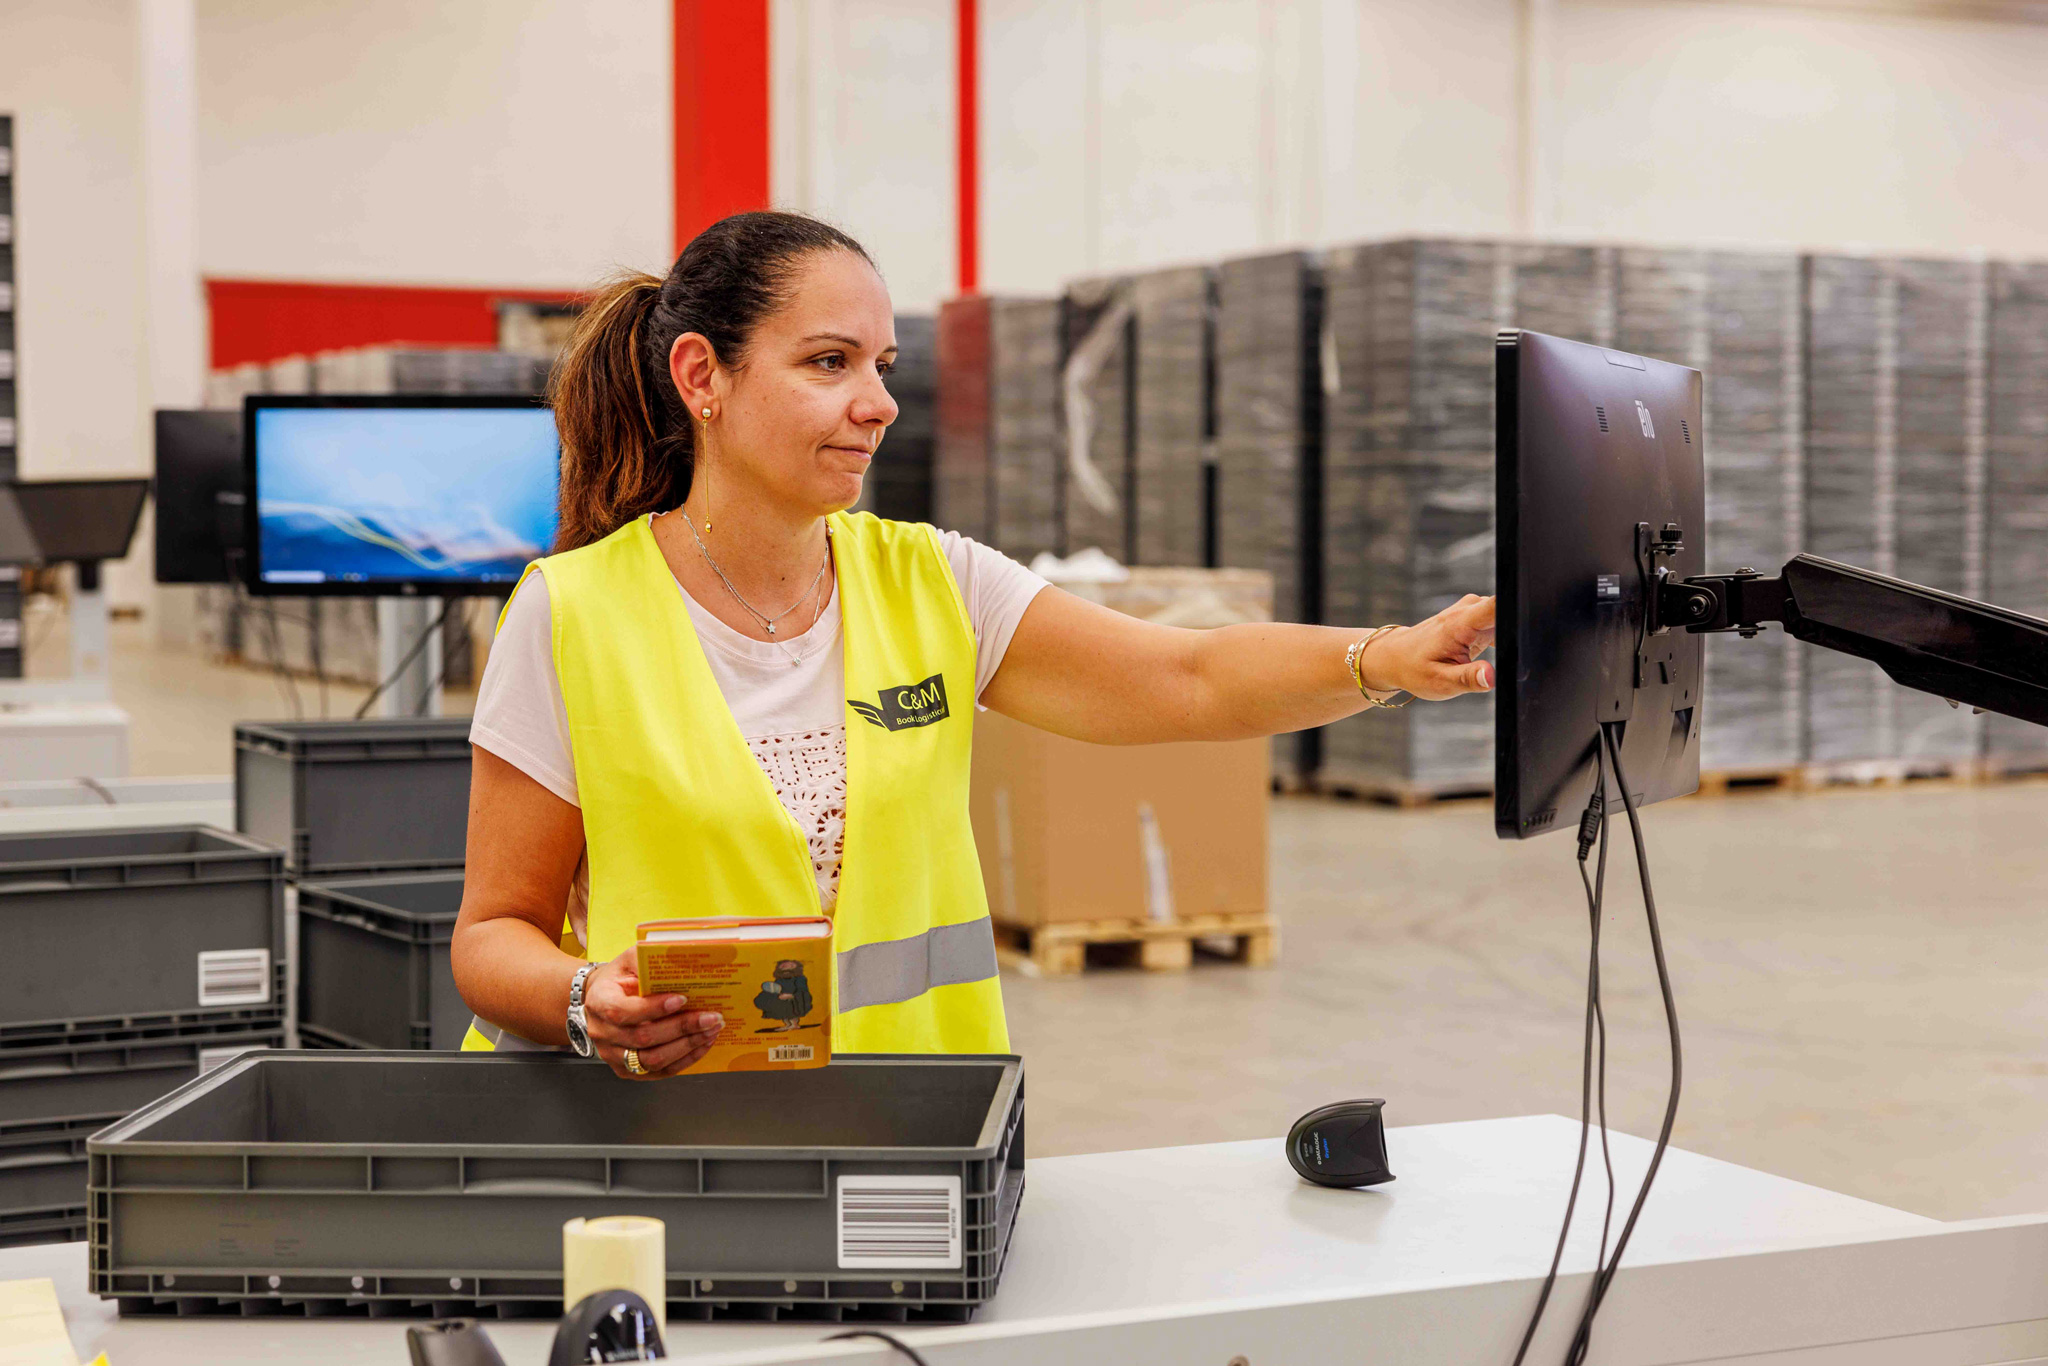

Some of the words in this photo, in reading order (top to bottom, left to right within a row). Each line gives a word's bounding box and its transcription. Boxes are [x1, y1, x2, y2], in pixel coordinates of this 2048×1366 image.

[898, 682, 941, 710] C&M
[896, 715, 915, 725] Book
[1313, 1131, 1322, 1161] DATALOGIC
